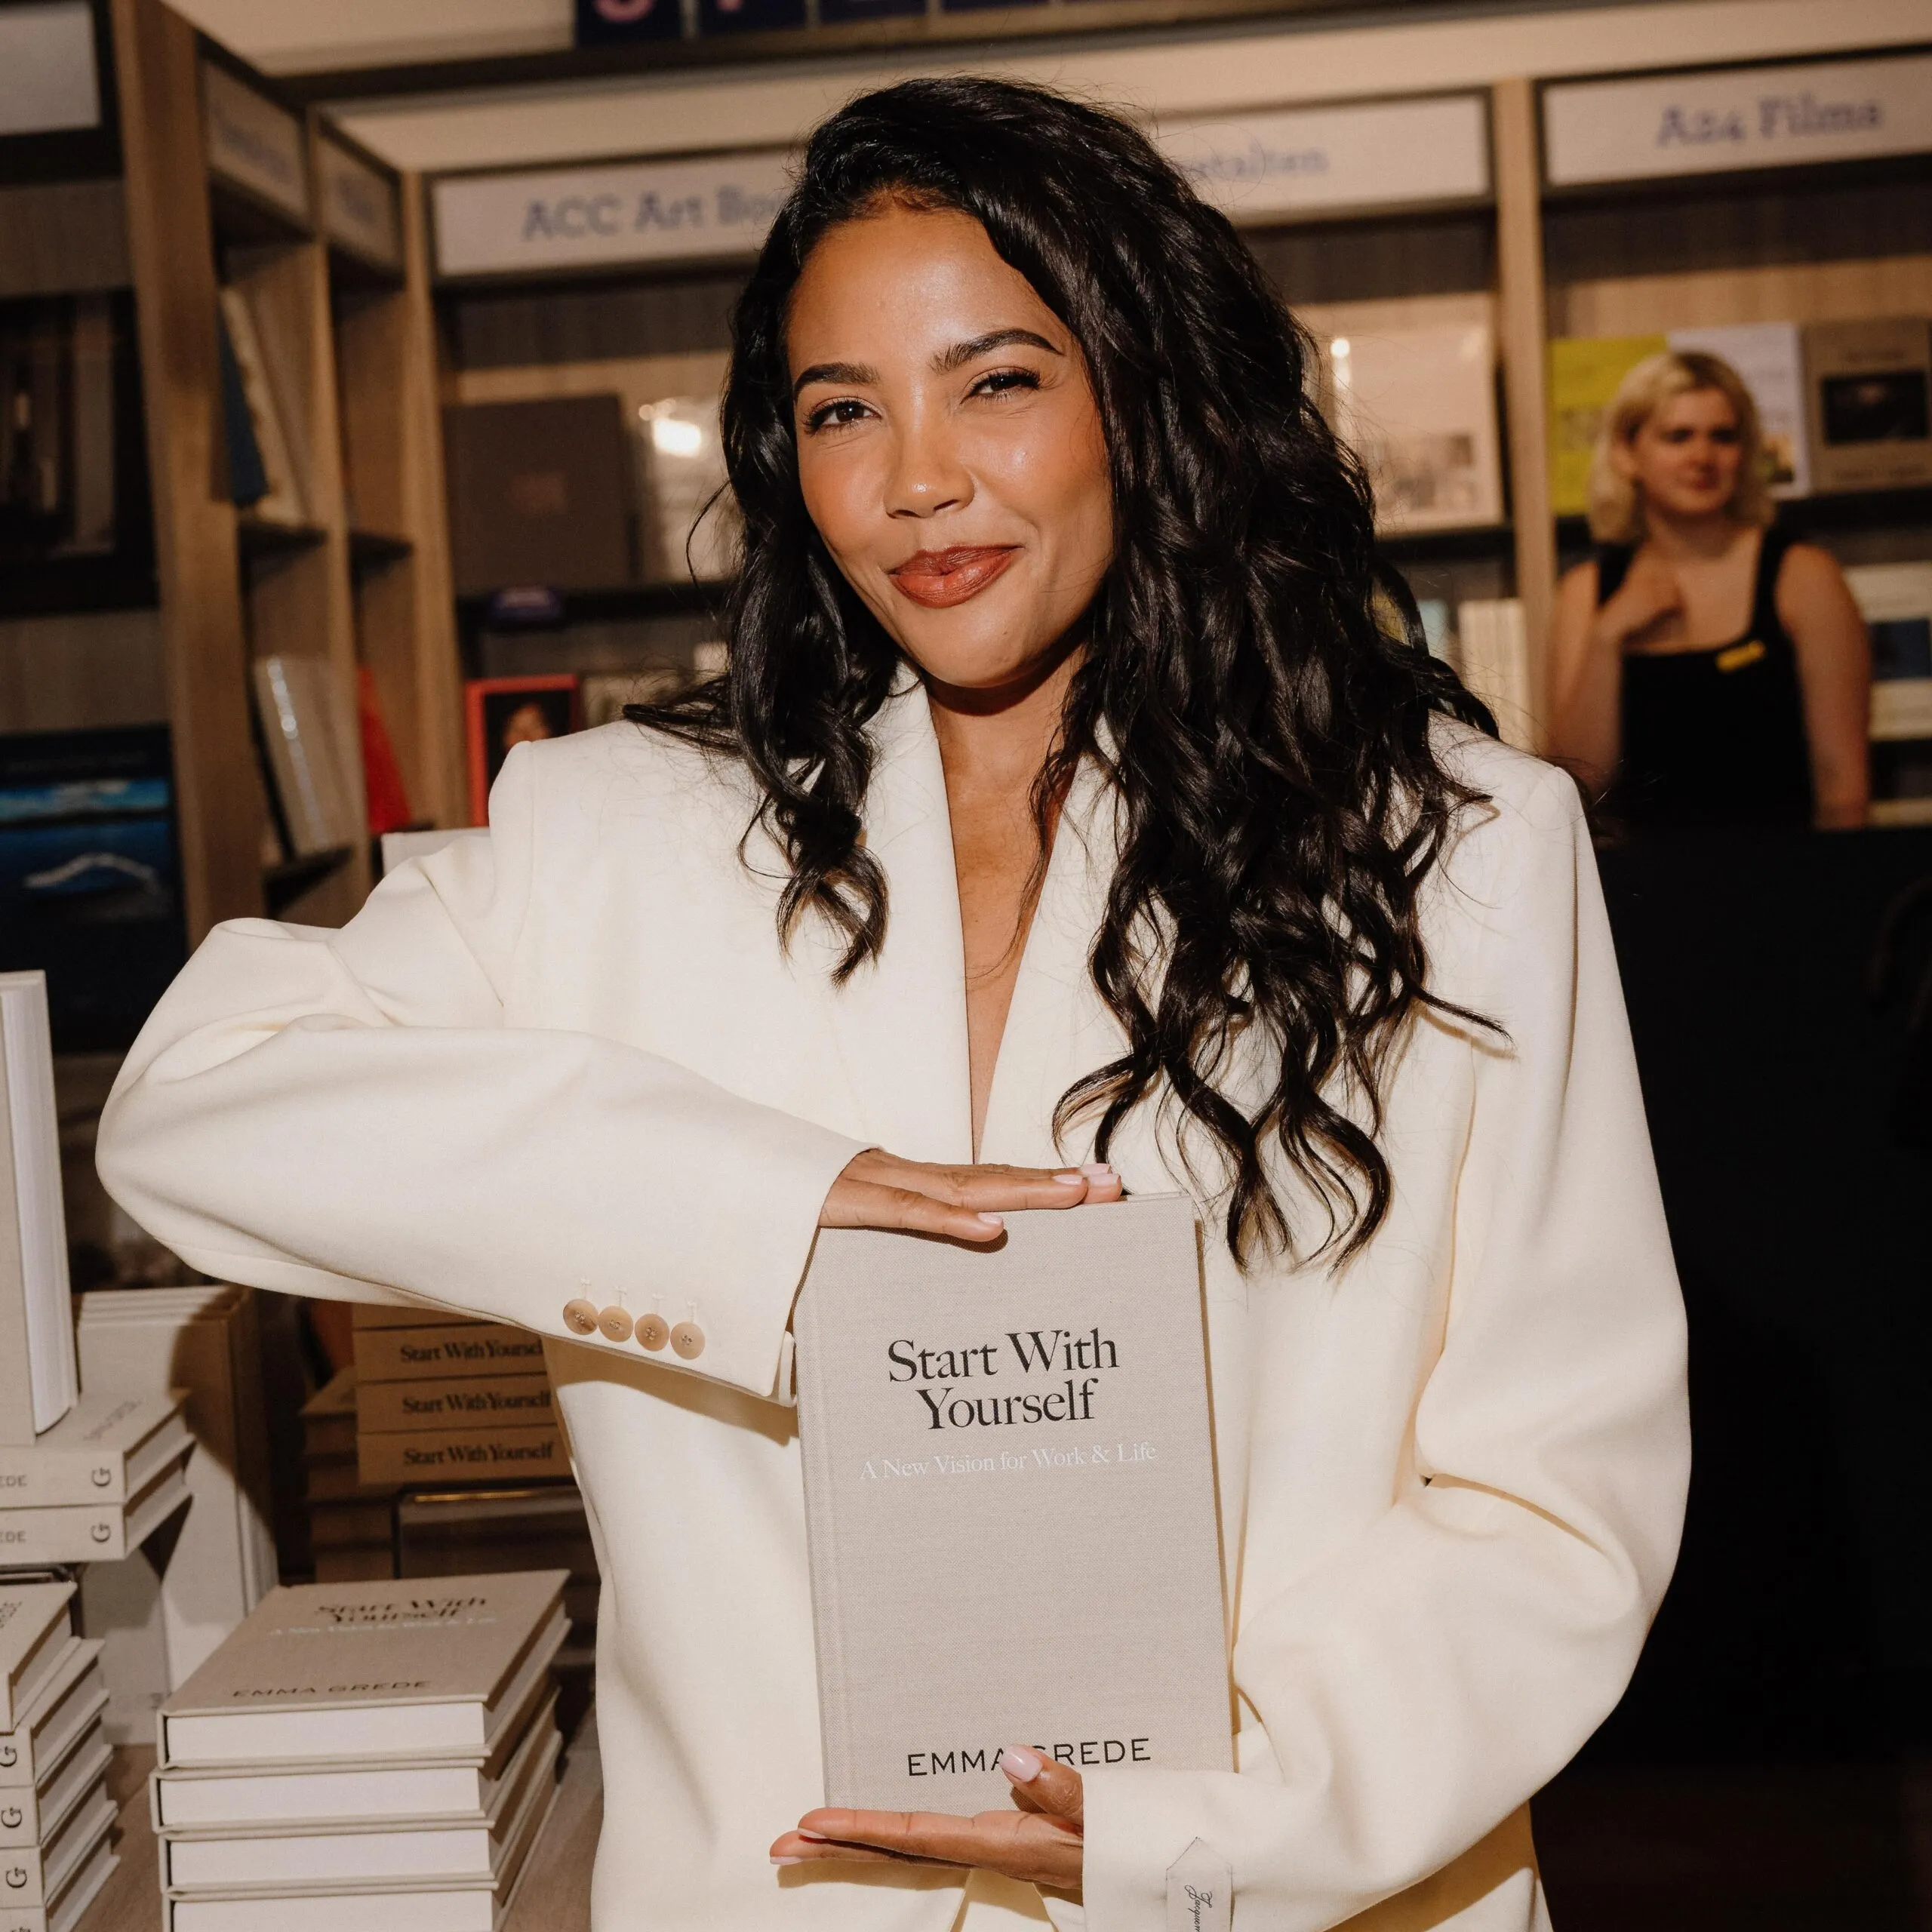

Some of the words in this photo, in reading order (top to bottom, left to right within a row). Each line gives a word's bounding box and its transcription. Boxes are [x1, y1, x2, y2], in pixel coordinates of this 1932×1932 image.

[1758, 89, 1884, 139] Films
[523, 194, 623, 242] ACC
[635, 189, 703, 232] Art
[400, 1344, 441, 1363] Start
[443, 1340, 485, 1359] With
[888, 1340, 998, 1383] Start
[1004, 1327, 1120, 1374] With
[401, 1396, 444, 1414] Start
[445, 1392, 488, 1411] With
[915, 1377, 1099, 1430] Yourself
[402, 1447, 444, 1466] Start
[448, 1444, 488, 1463] With
[489, 1441, 555, 1463] Yourself
[859, 1460, 878, 1480] A
[882, 1457, 930, 1479] New
[933, 1454, 995, 1474] Vision
[1000, 1451, 1028, 1470] for
[1032, 1446, 1087, 1467] Work
[1091, 1444, 1112, 1463] &
[1117, 1441, 1156, 1462] Life
[232, 1687, 317, 1697] EMMA
[328, 1680, 431, 1693] GREDE
[908, 1747, 1004, 1777] EMMA
[1032, 1737, 1152, 1766] REDE
